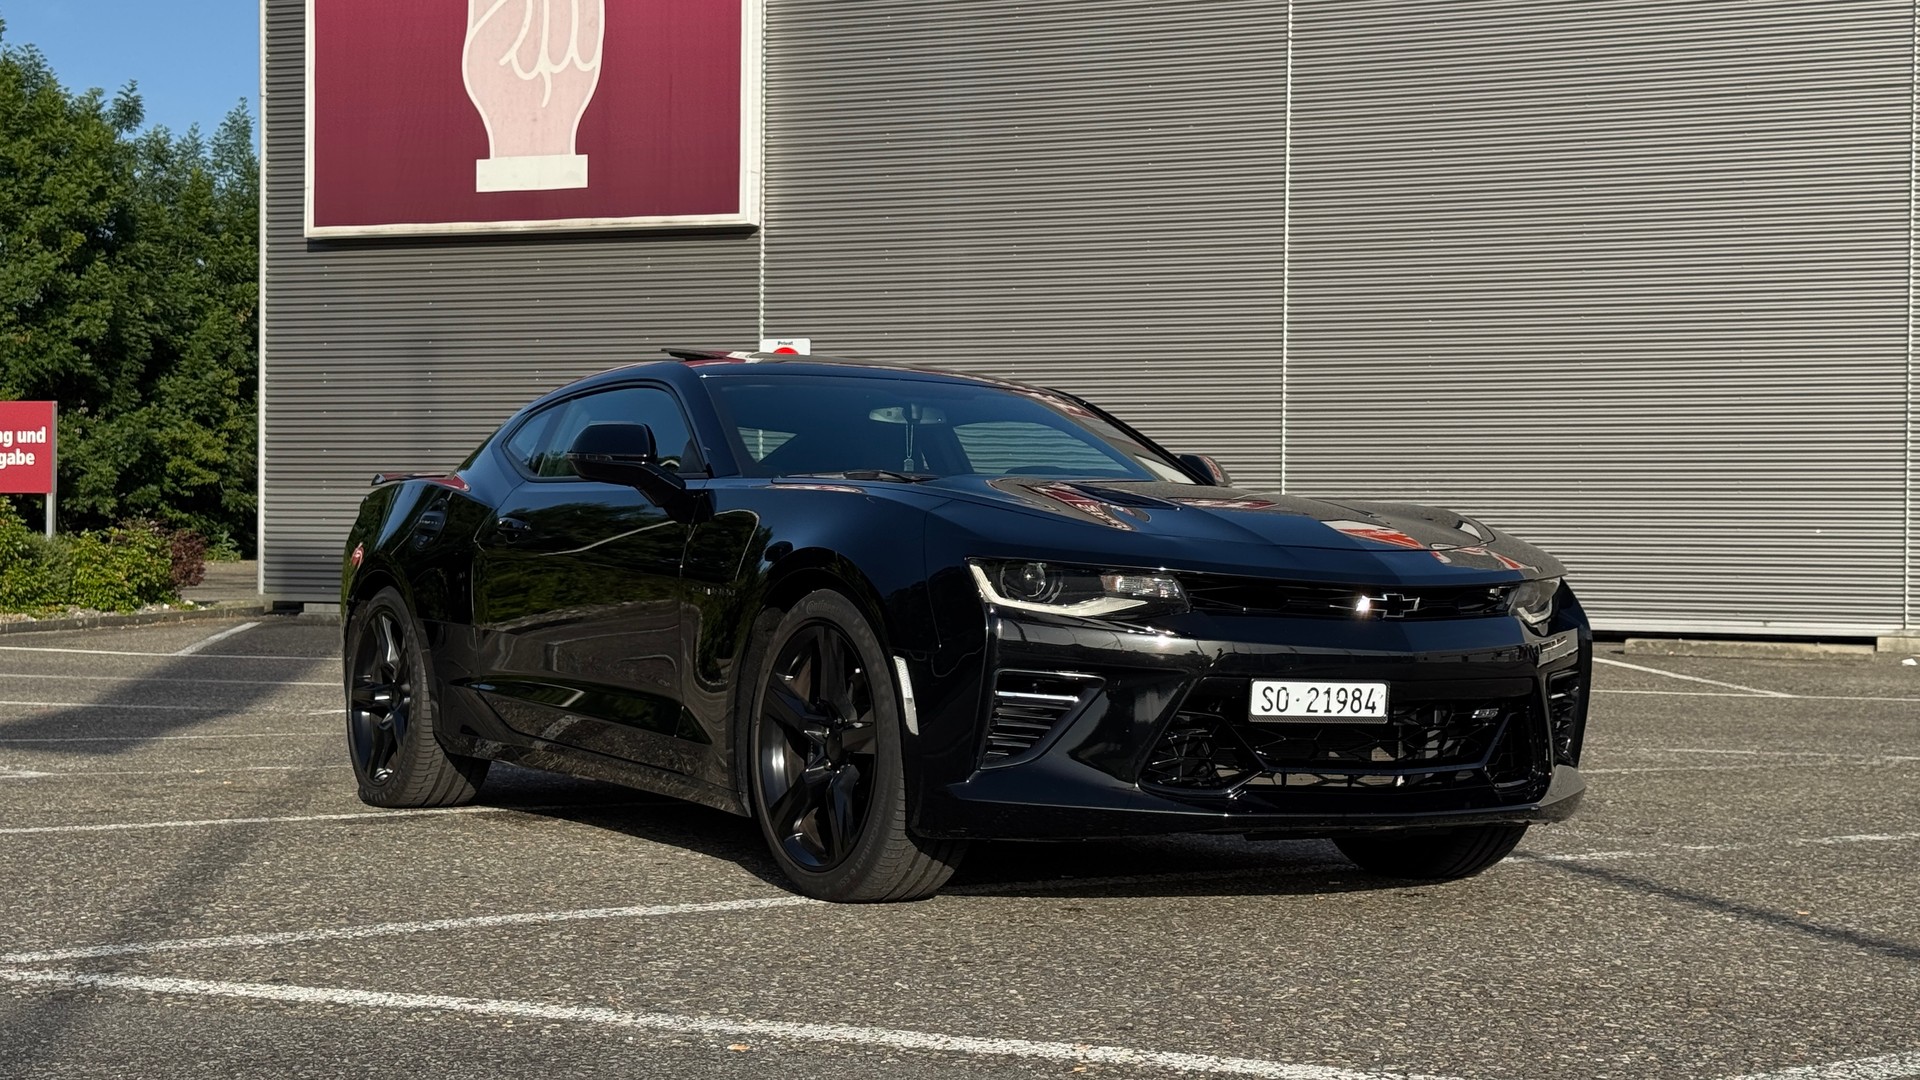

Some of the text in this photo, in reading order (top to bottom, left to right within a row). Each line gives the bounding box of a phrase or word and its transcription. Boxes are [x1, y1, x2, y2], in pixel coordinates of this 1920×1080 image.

[17, 426, 46, 443] und
[0, 448, 35, 469] gabe
[1261, 686, 1289, 713] SO
[1306, 687, 1376, 714] 21984
